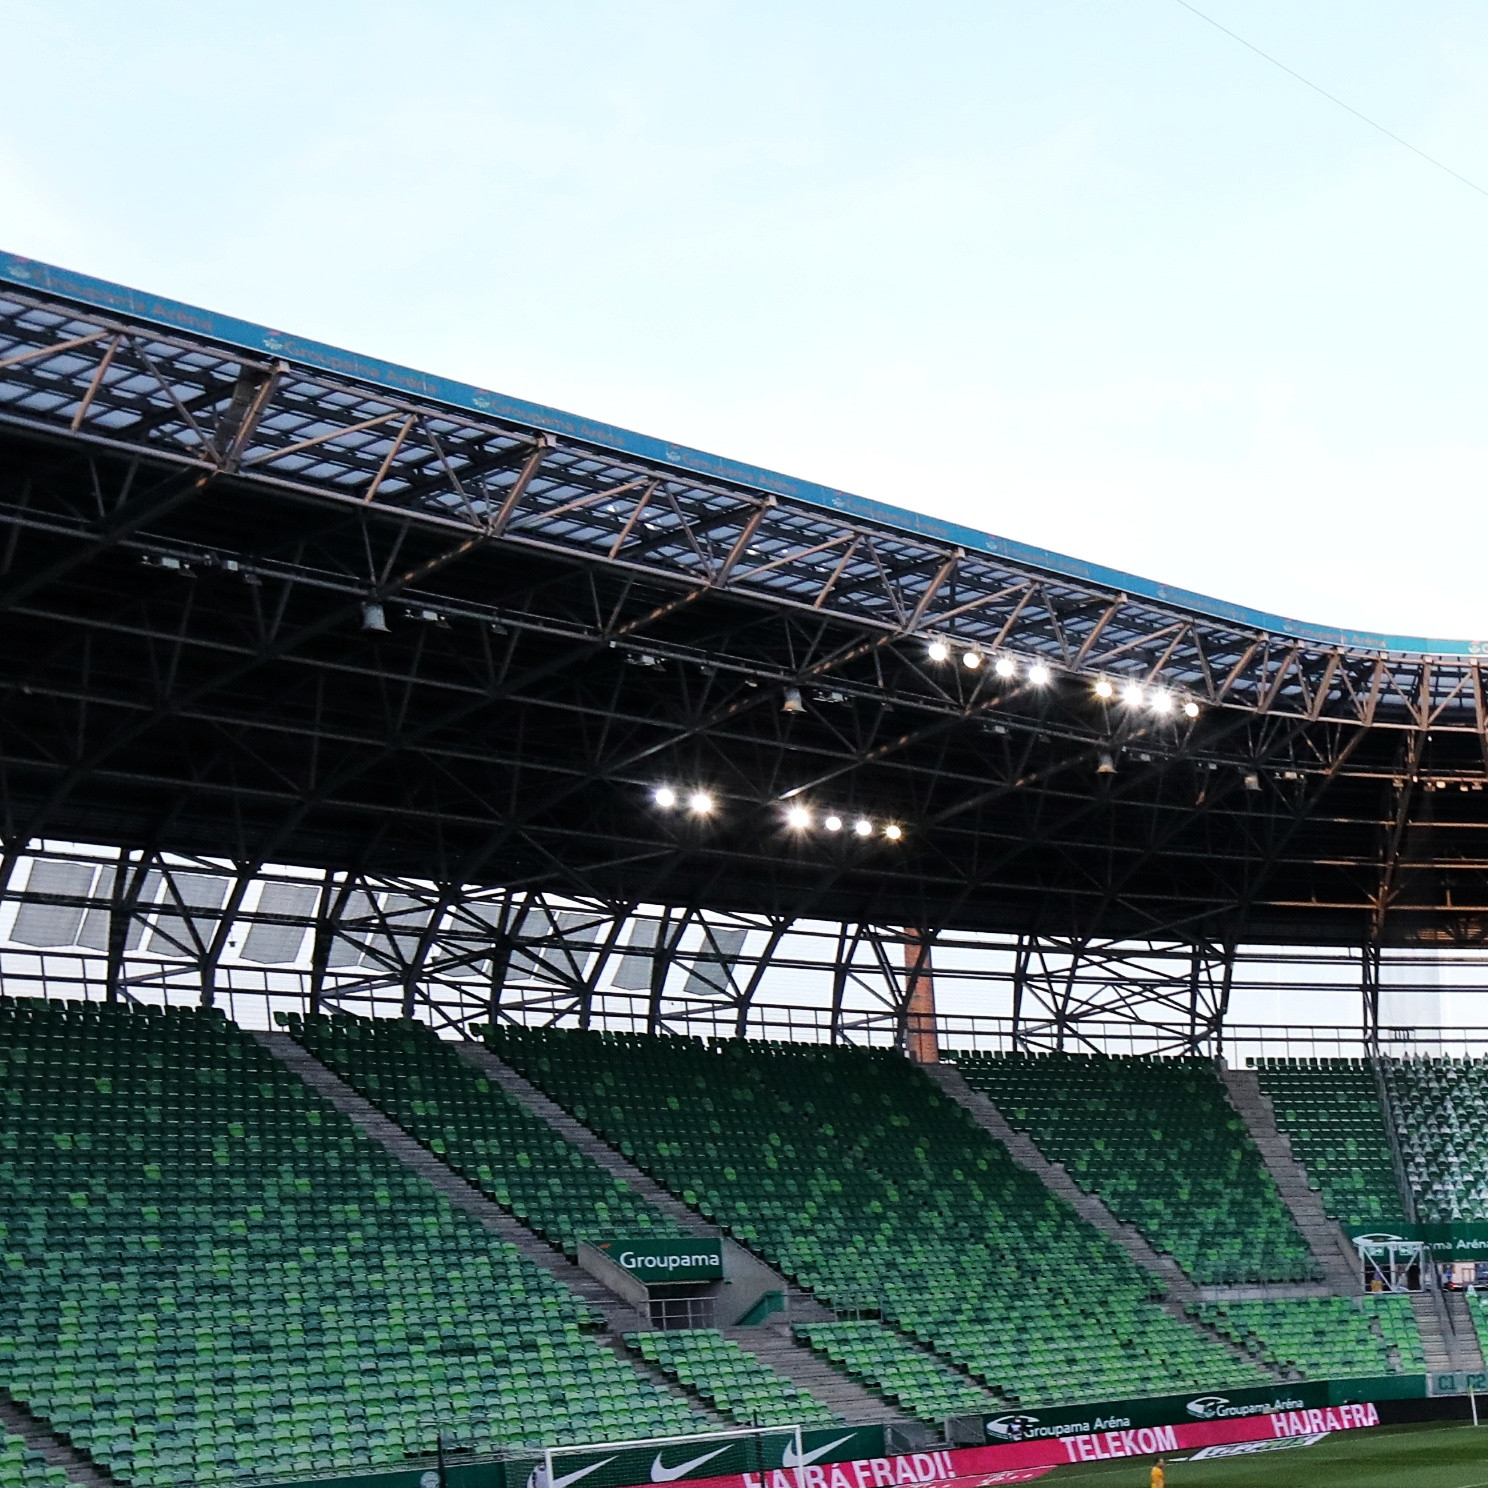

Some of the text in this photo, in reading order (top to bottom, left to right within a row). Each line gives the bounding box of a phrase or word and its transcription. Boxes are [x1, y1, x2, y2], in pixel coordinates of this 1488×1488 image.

[620, 1251, 720, 1271] Groupama
[1216, 1396, 1305, 1418] Groupama Aréna
[1094, 1416, 1130, 1431] Aréna
[1271, 1405, 1340, 1438] HAJRÁ
[1060, 1425, 1179, 1463] TELEKOM
[852, 1450, 956, 1488] FRADI!
